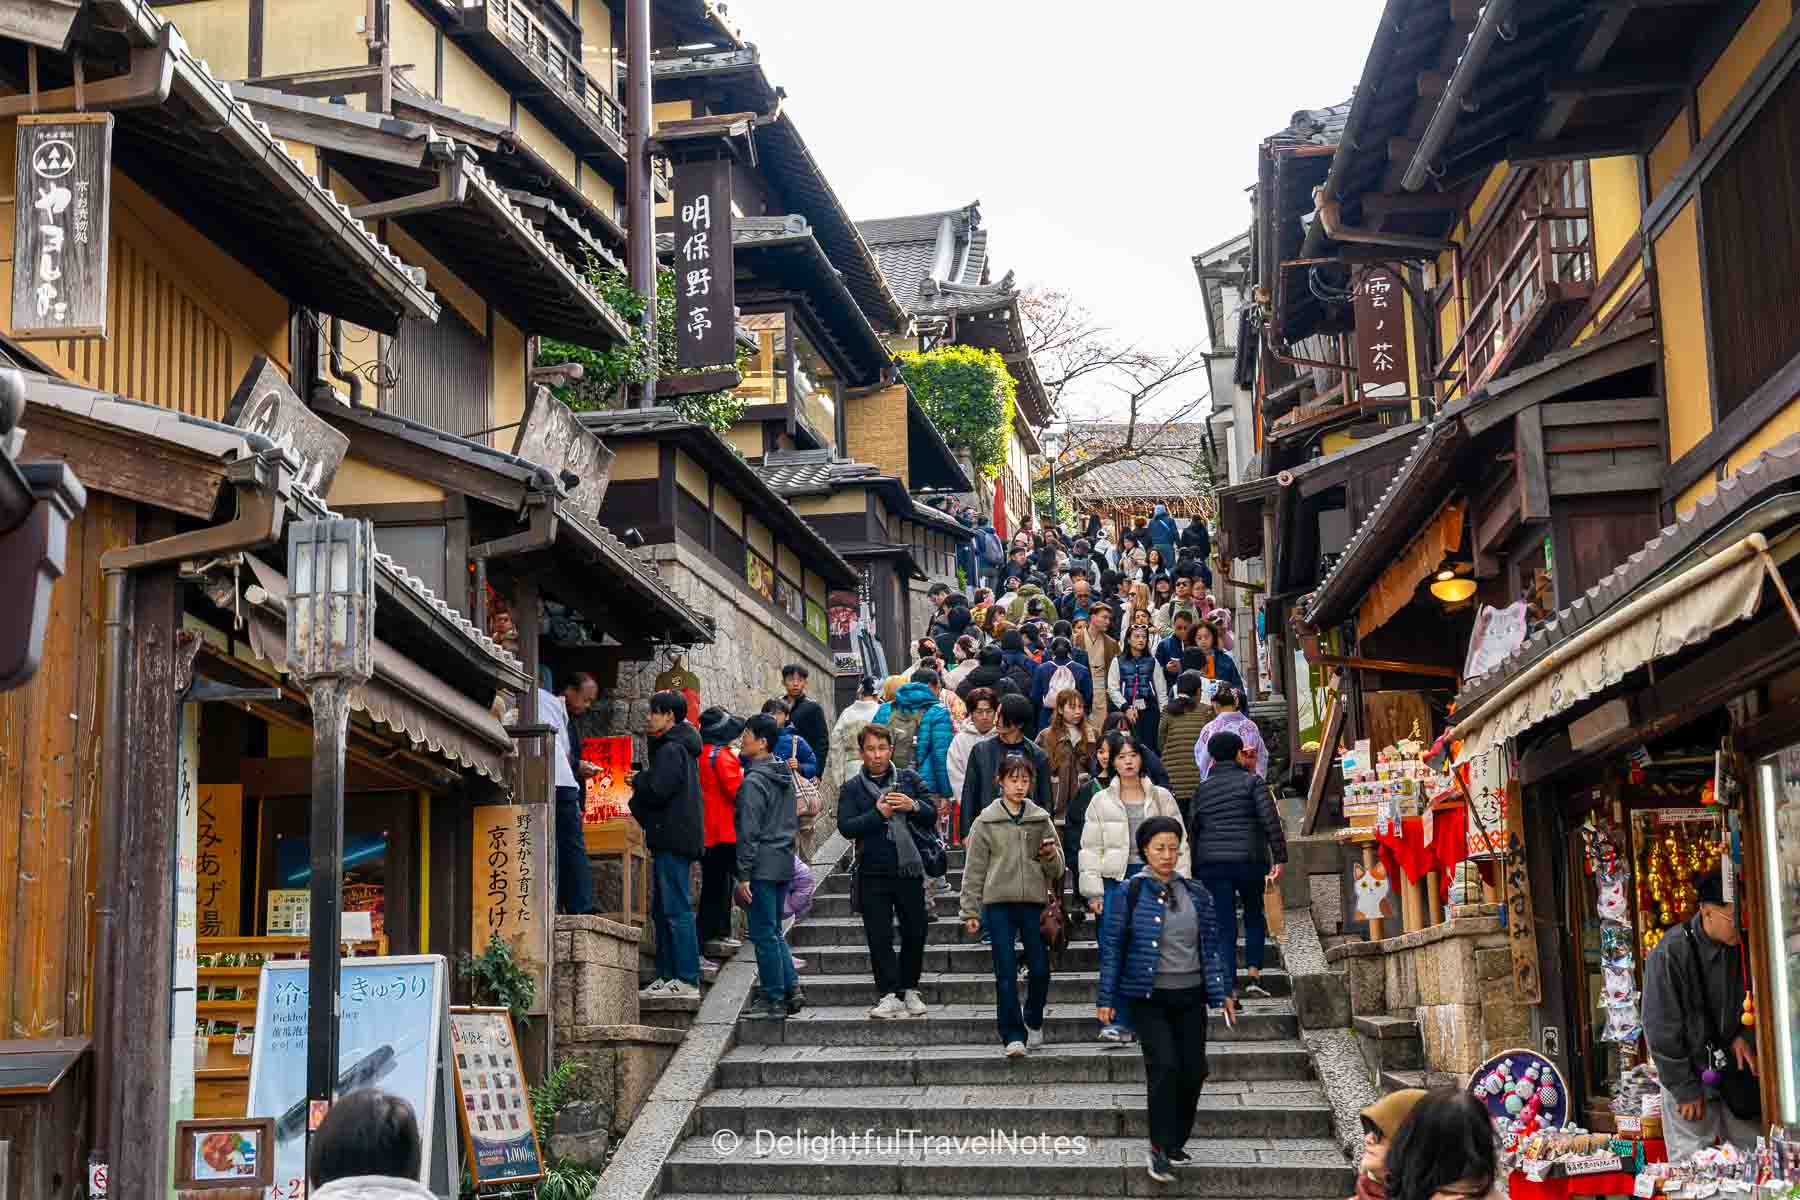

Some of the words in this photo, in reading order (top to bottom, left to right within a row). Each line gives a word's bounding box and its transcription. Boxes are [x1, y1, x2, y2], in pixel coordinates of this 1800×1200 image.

[681, 194, 712, 341] 明保野亭
[1364, 276, 1394, 372] 雲ノ茶
[487, 825, 509, 938] 京のおつけ
[516, 814, 532, 922] 野菜から育てた
